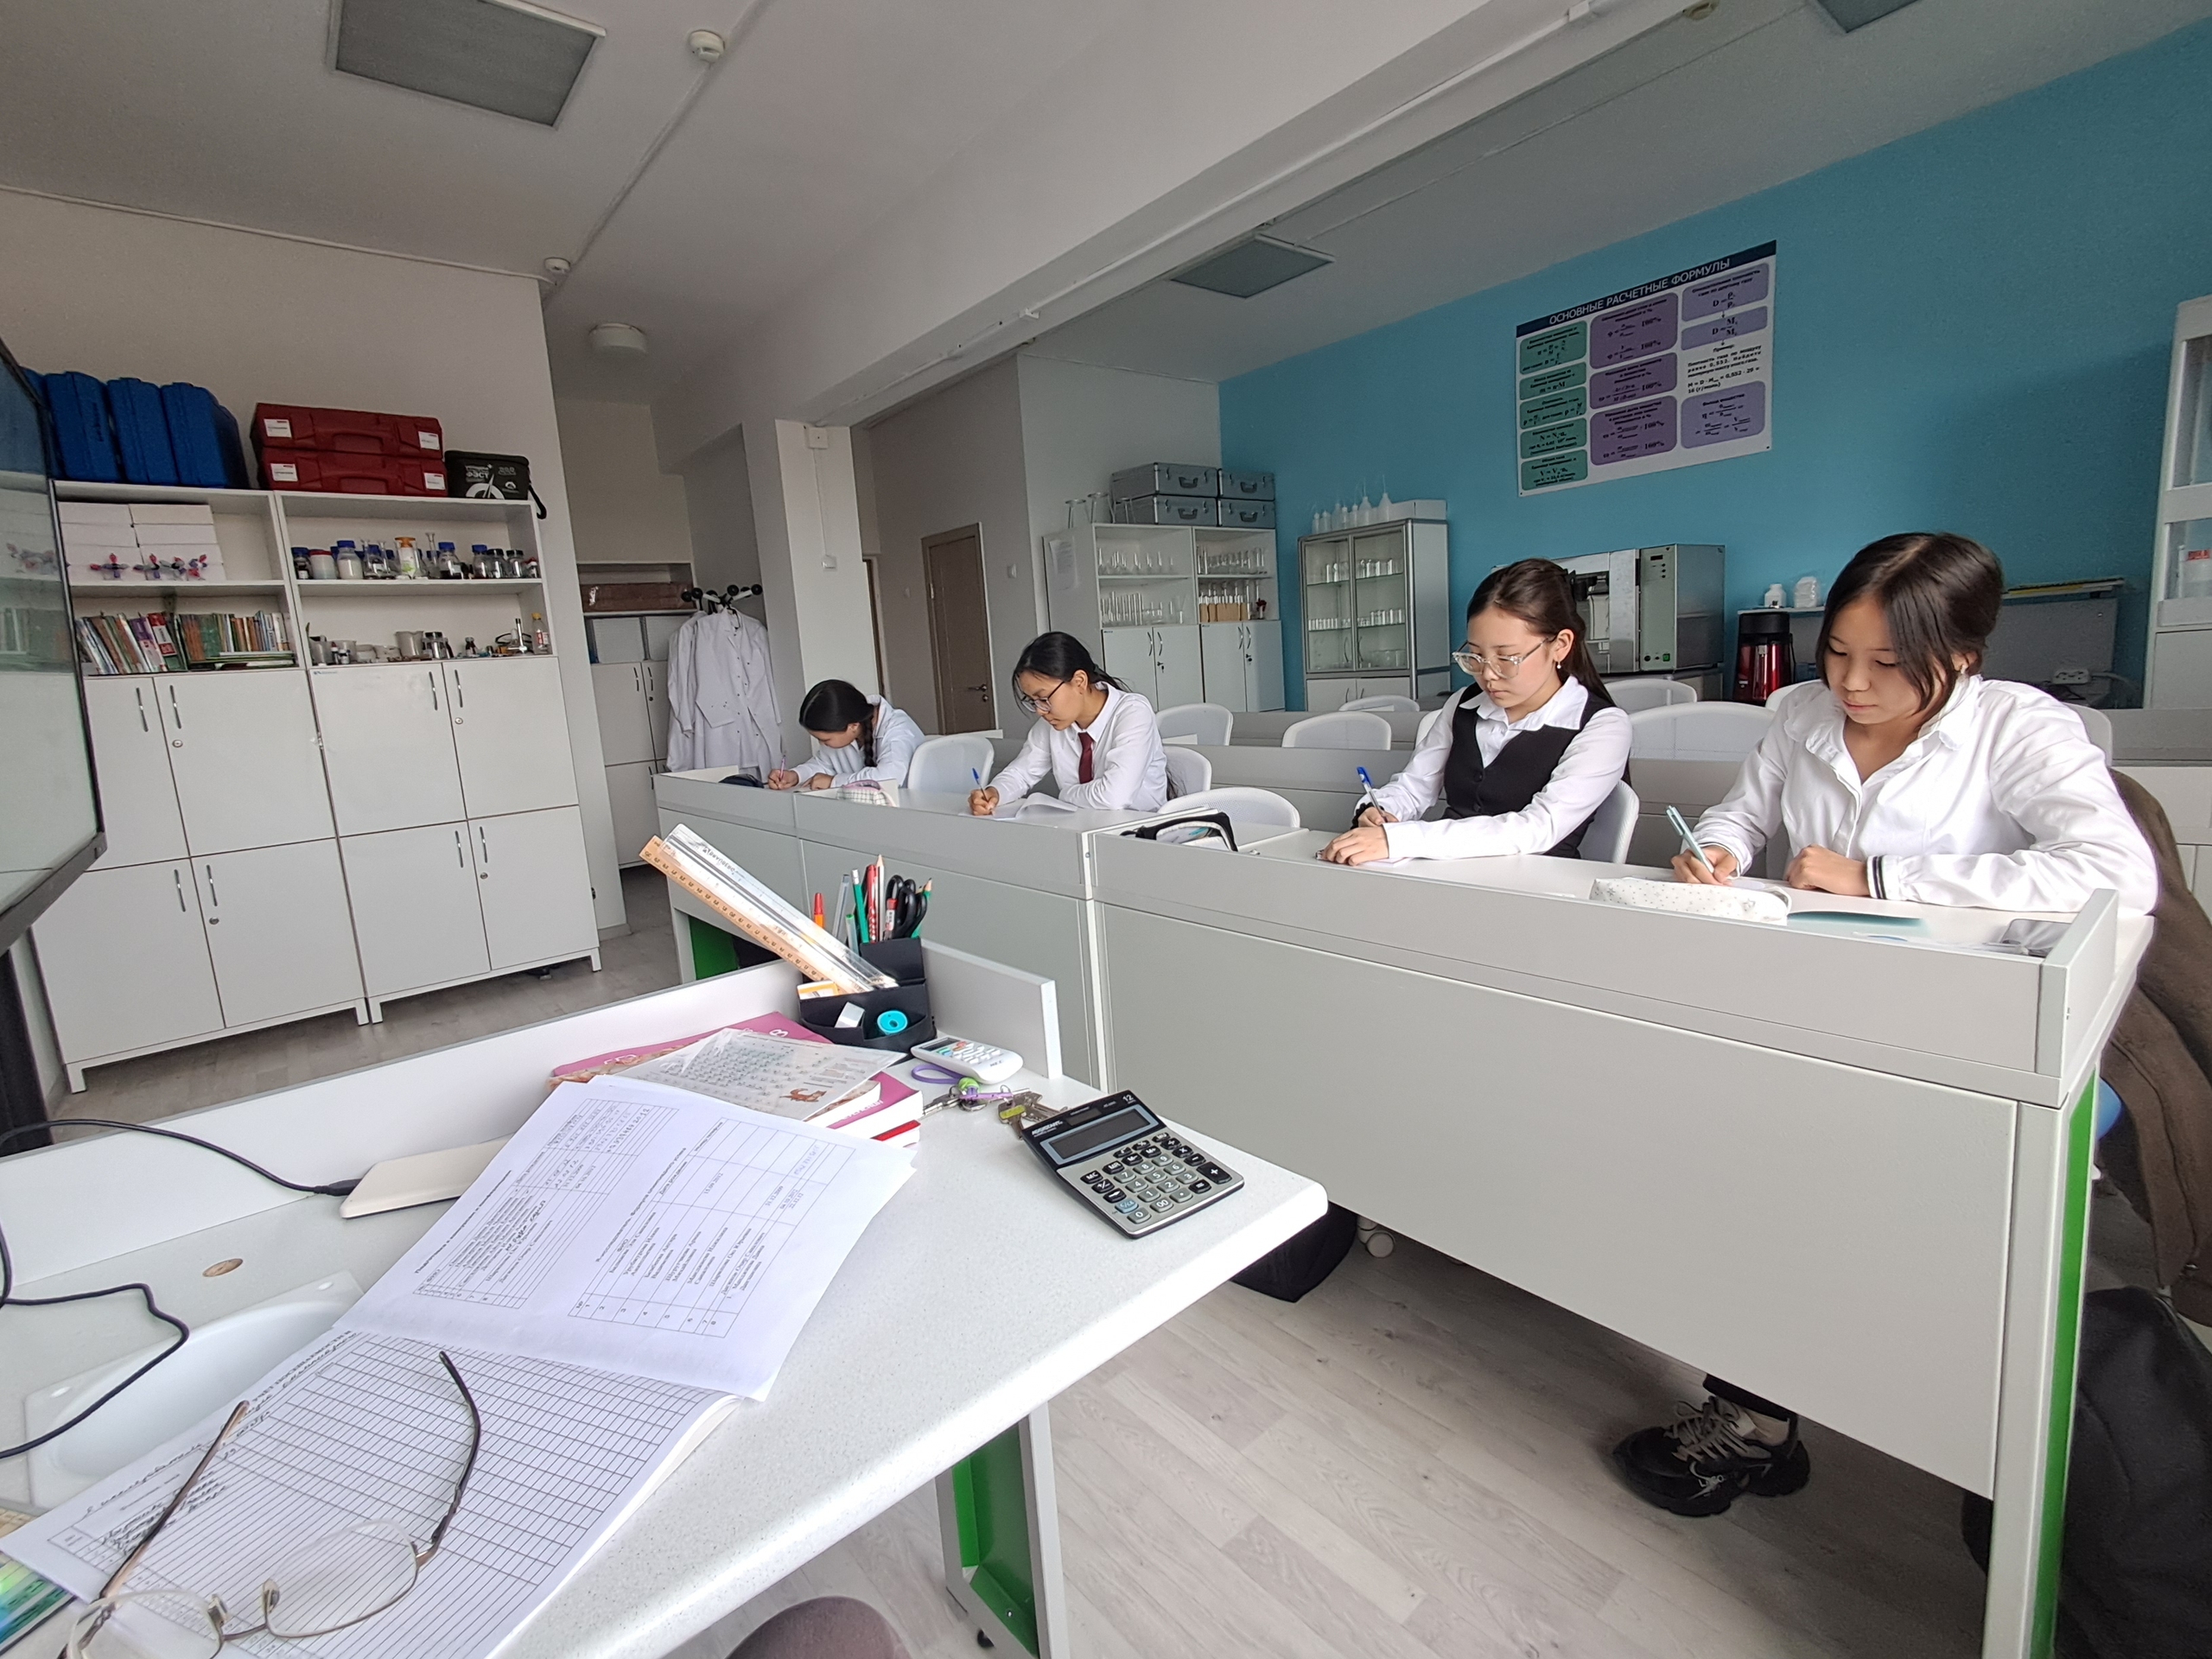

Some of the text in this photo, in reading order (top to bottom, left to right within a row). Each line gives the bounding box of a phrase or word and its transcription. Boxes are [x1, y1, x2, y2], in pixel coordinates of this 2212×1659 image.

[1549, 301, 1604, 325] ОСНОВНЫЕ
[1606, 278, 1669, 306] РАСЧЕТНЫЕ
[1672, 258, 1730, 285] ФОРМУЛЫ
